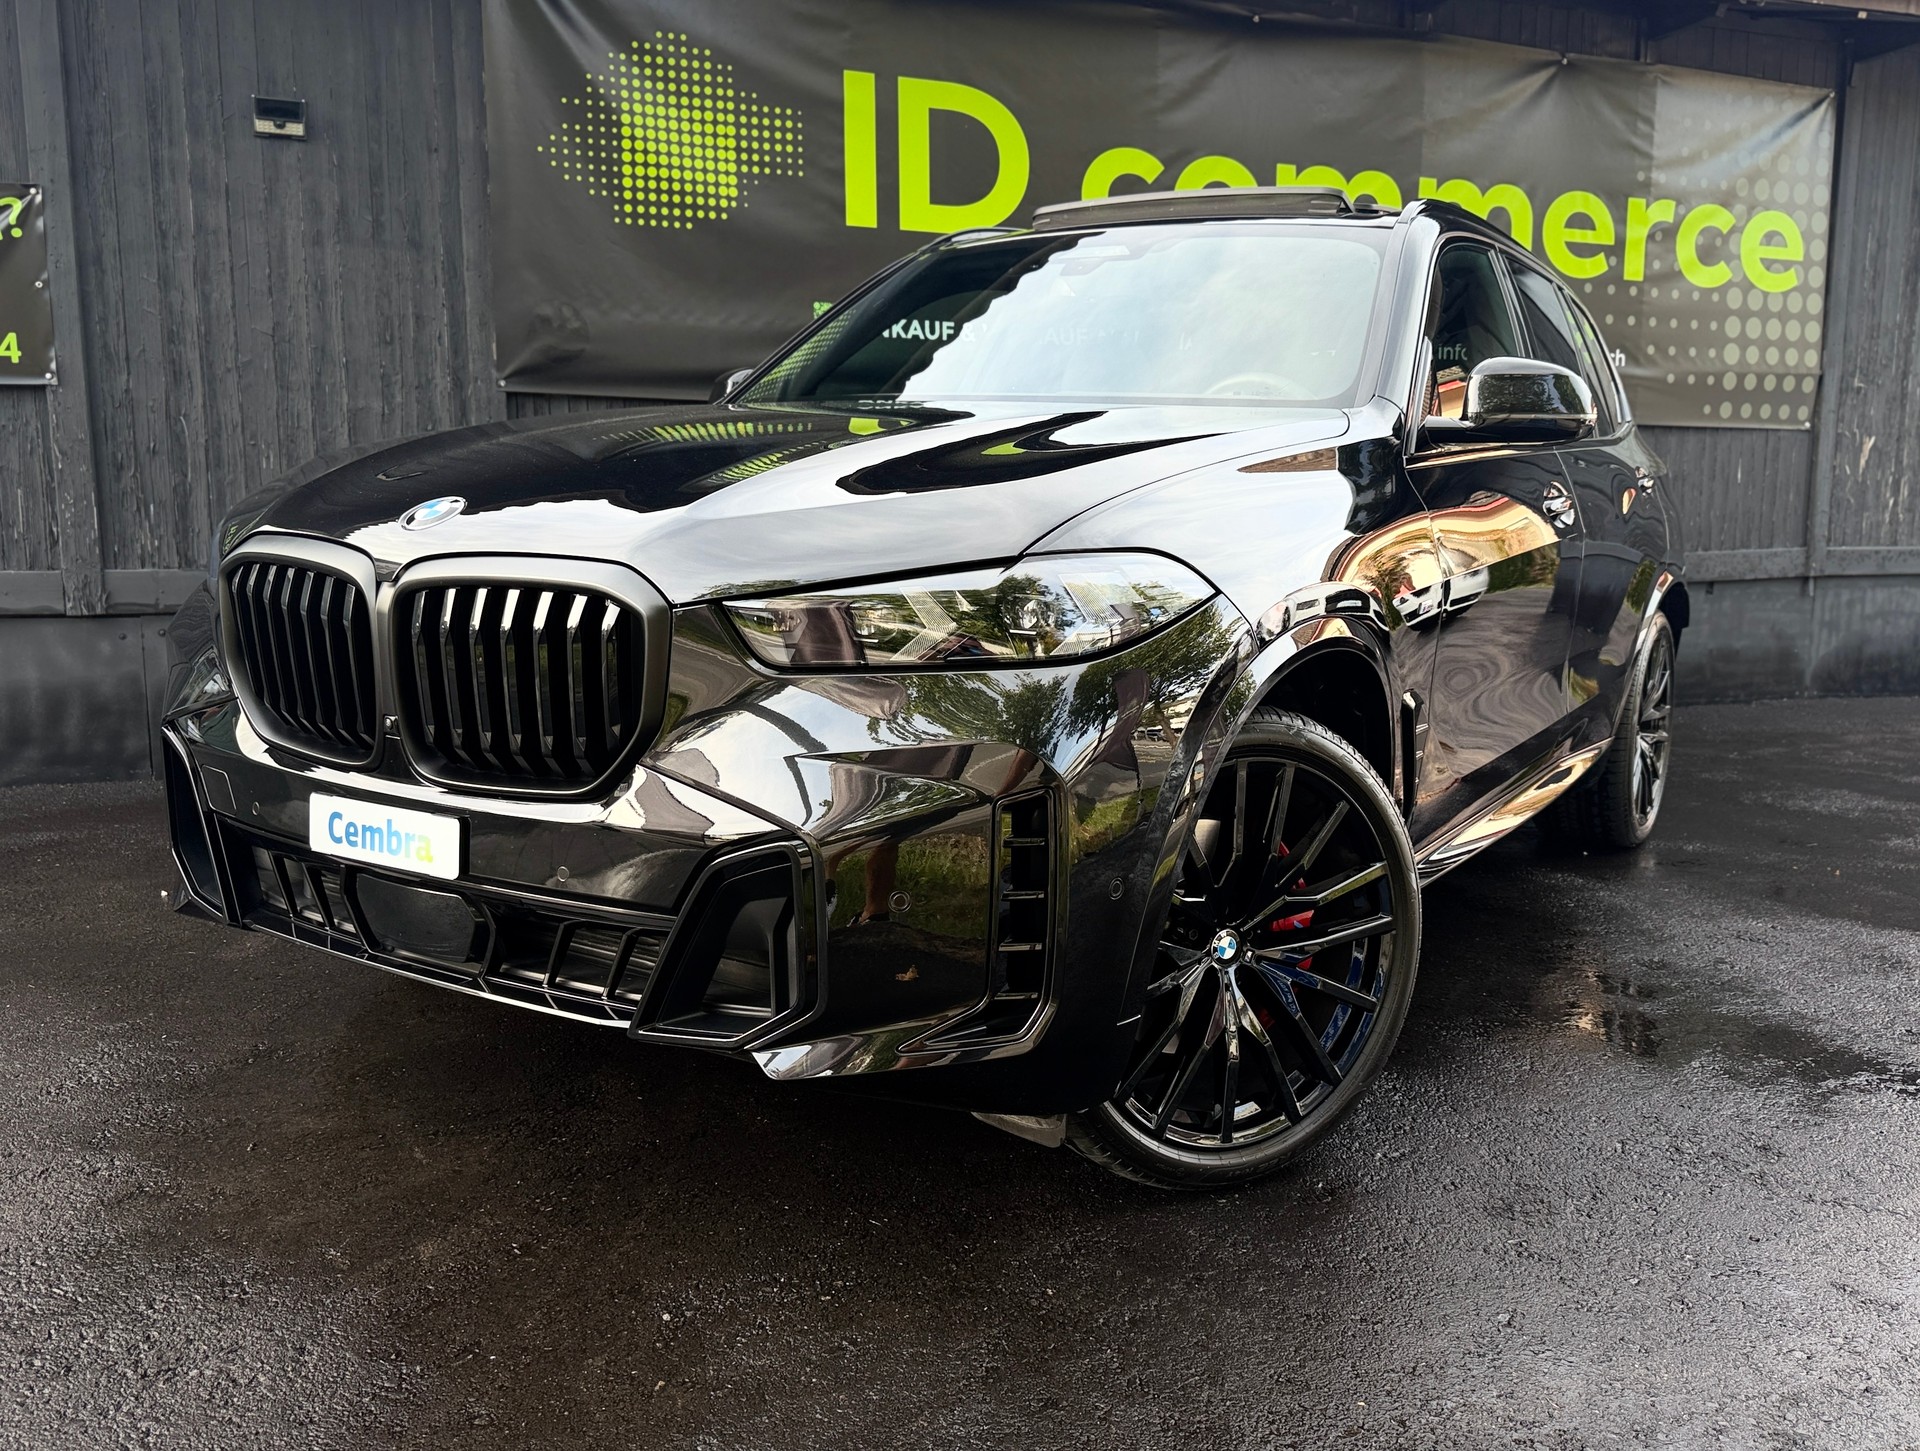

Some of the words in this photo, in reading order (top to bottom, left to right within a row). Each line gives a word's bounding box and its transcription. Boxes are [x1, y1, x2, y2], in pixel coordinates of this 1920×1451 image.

[843, 69, 1030, 234] ID
[882, 319, 955, 341] KAUF
[328, 811, 434, 863] Cembra
